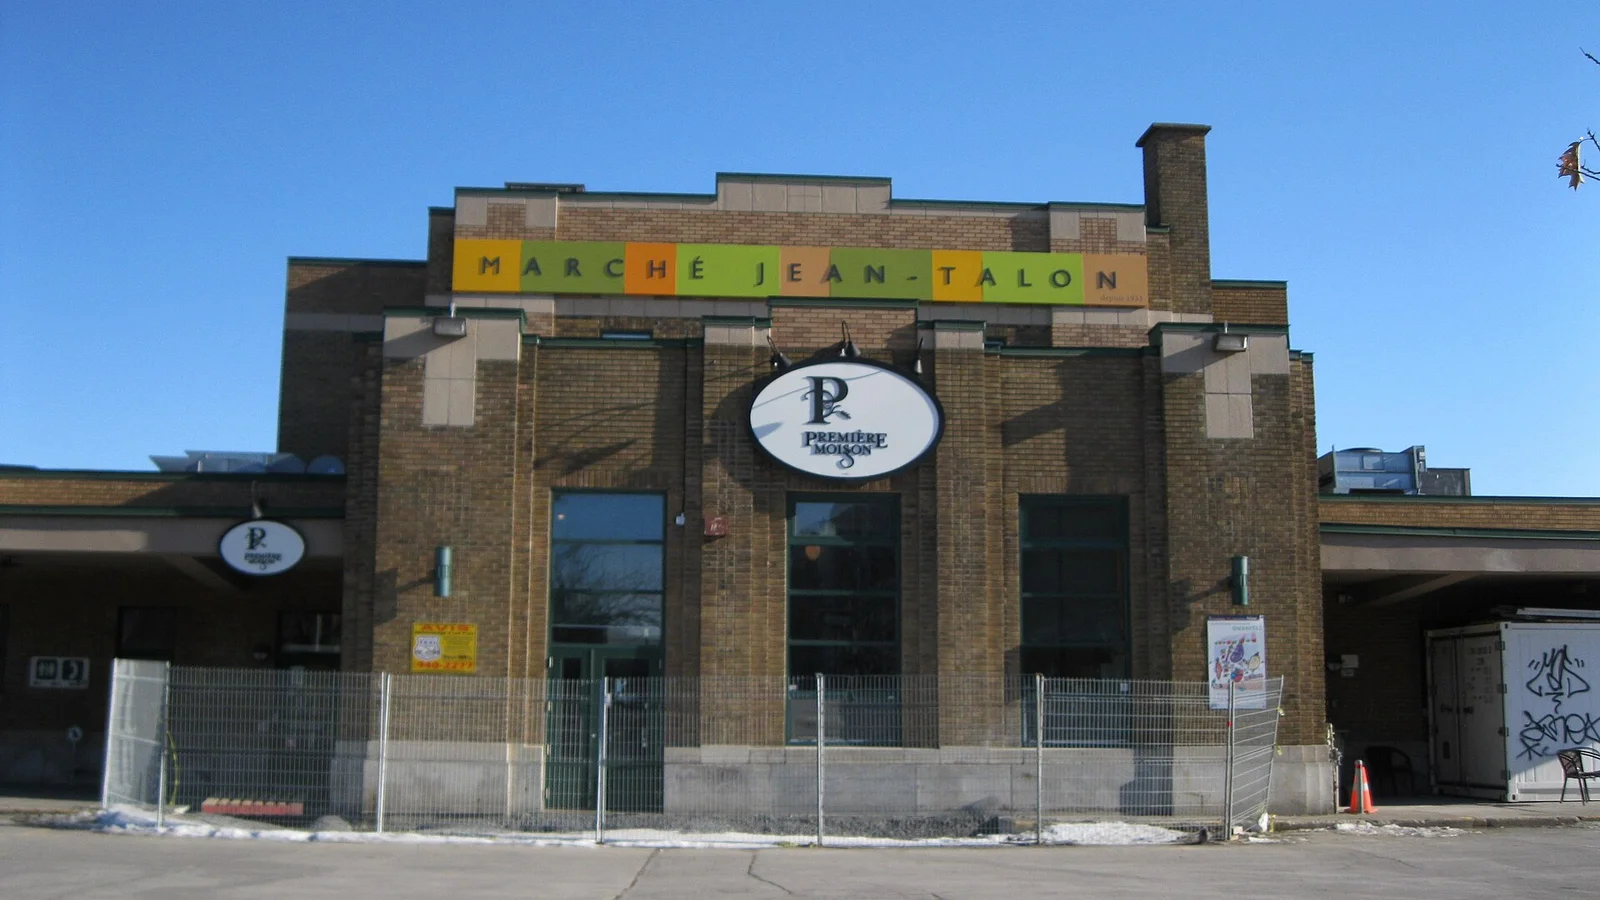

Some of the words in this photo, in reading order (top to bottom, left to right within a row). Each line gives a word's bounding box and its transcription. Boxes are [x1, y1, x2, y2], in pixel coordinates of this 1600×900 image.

[478, 256, 704, 279] MARCHÉ
[803, 429, 888, 449] PREMIÈRE
[811, 444, 872, 468] MOISON
